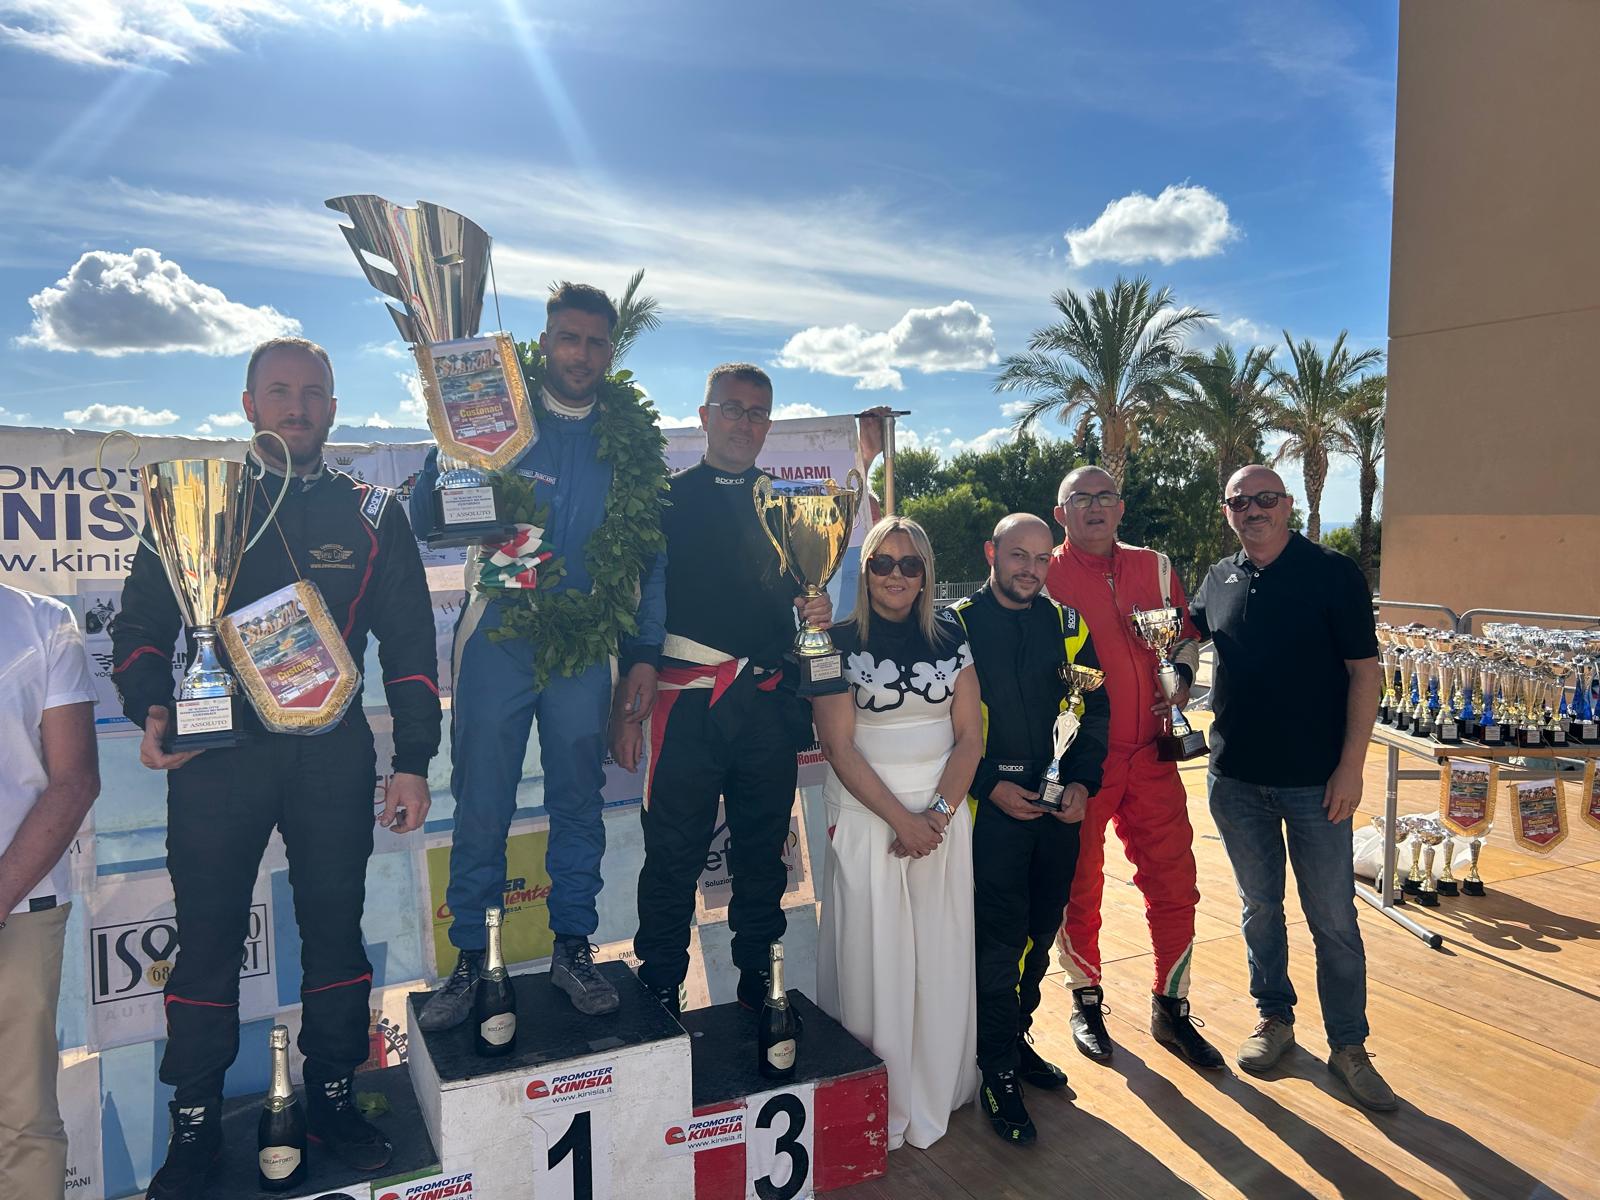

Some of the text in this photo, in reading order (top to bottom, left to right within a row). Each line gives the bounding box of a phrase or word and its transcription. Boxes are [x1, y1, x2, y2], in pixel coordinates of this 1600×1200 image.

[715, 476, 745, 485] sparco
[781, 466, 831, 480] MARMI
[277, 655, 320, 681] Custonaci
[191, 720, 227, 728] ASSOLUTO
[998, 764, 1024, 772] sparco
[384, 1029, 407, 1055] CLUB
[551, 1067, 613, 1084] PROMOTER
[551, 1074, 613, 1096] KINISIA
[551, 1086, 613, 1104] www.kinisia.it
[688, 1114, 744, 1131] PROMOTER
[687, 1122, 743, 1142] KINISIA
[687, 1133, 743, 1150] www.kinisia.it
[753, 1092, 809, 1200] 3
[547, 1110, 593, 1200] 1
[405, 1172, 473, 1196] PROMOTER
